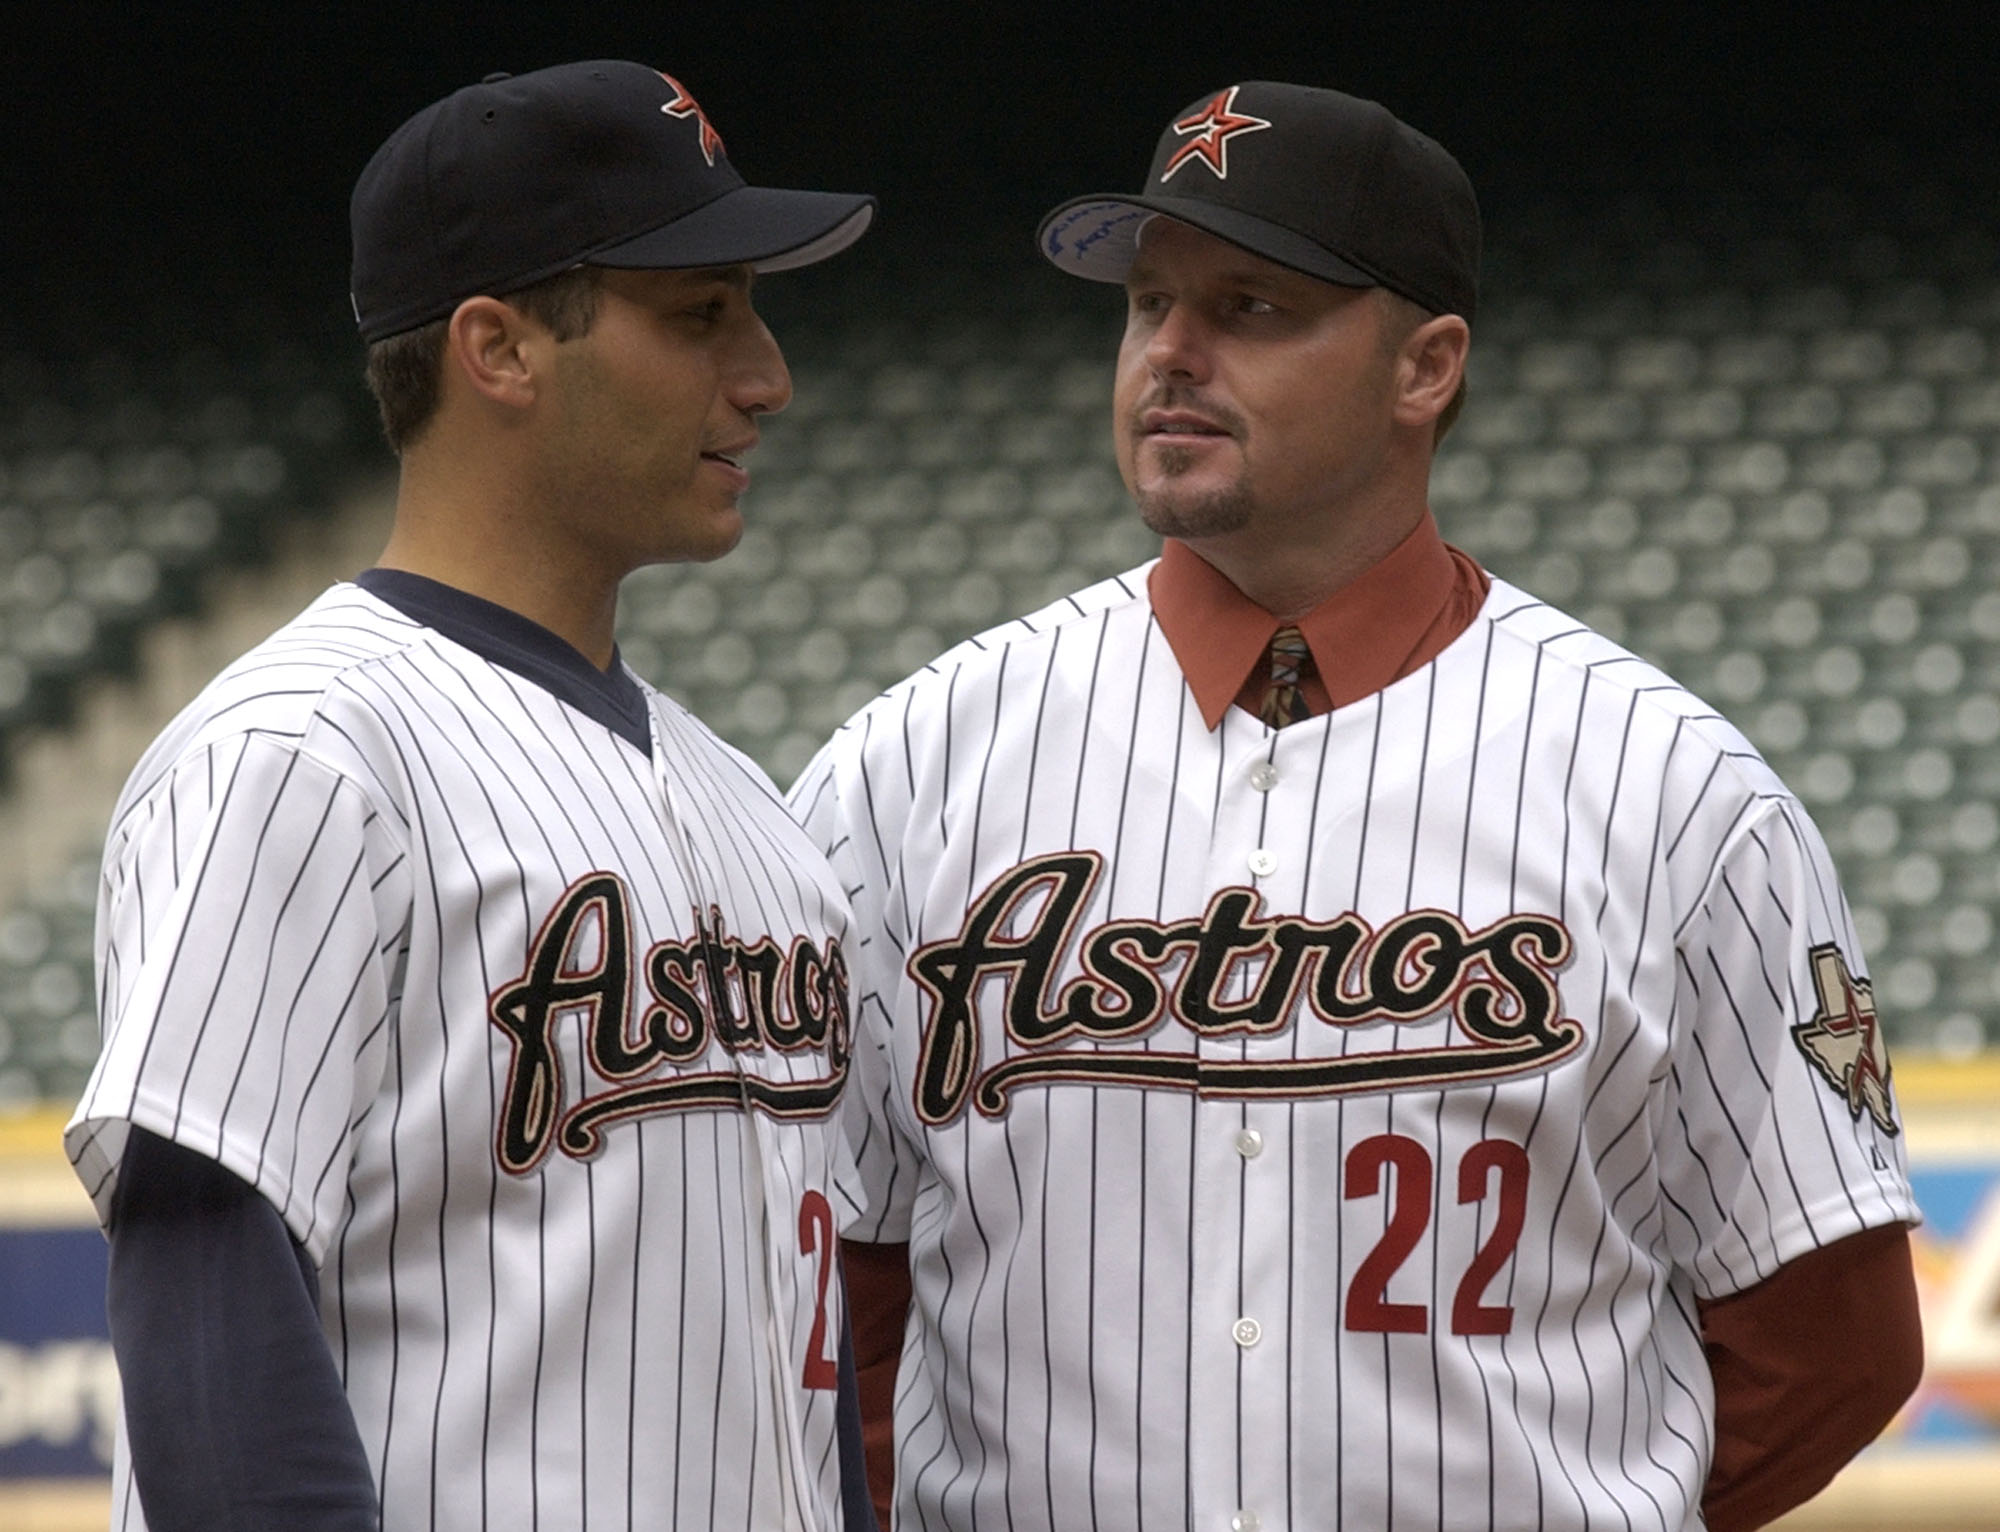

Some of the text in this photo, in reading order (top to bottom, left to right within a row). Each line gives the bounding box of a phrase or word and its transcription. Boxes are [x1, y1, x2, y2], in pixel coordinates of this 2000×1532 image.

[488, 871, 850, 1174] Astros
[908, 850, 1583, 1125] Astros
[1345, 1134, 1530, 1335] 22
